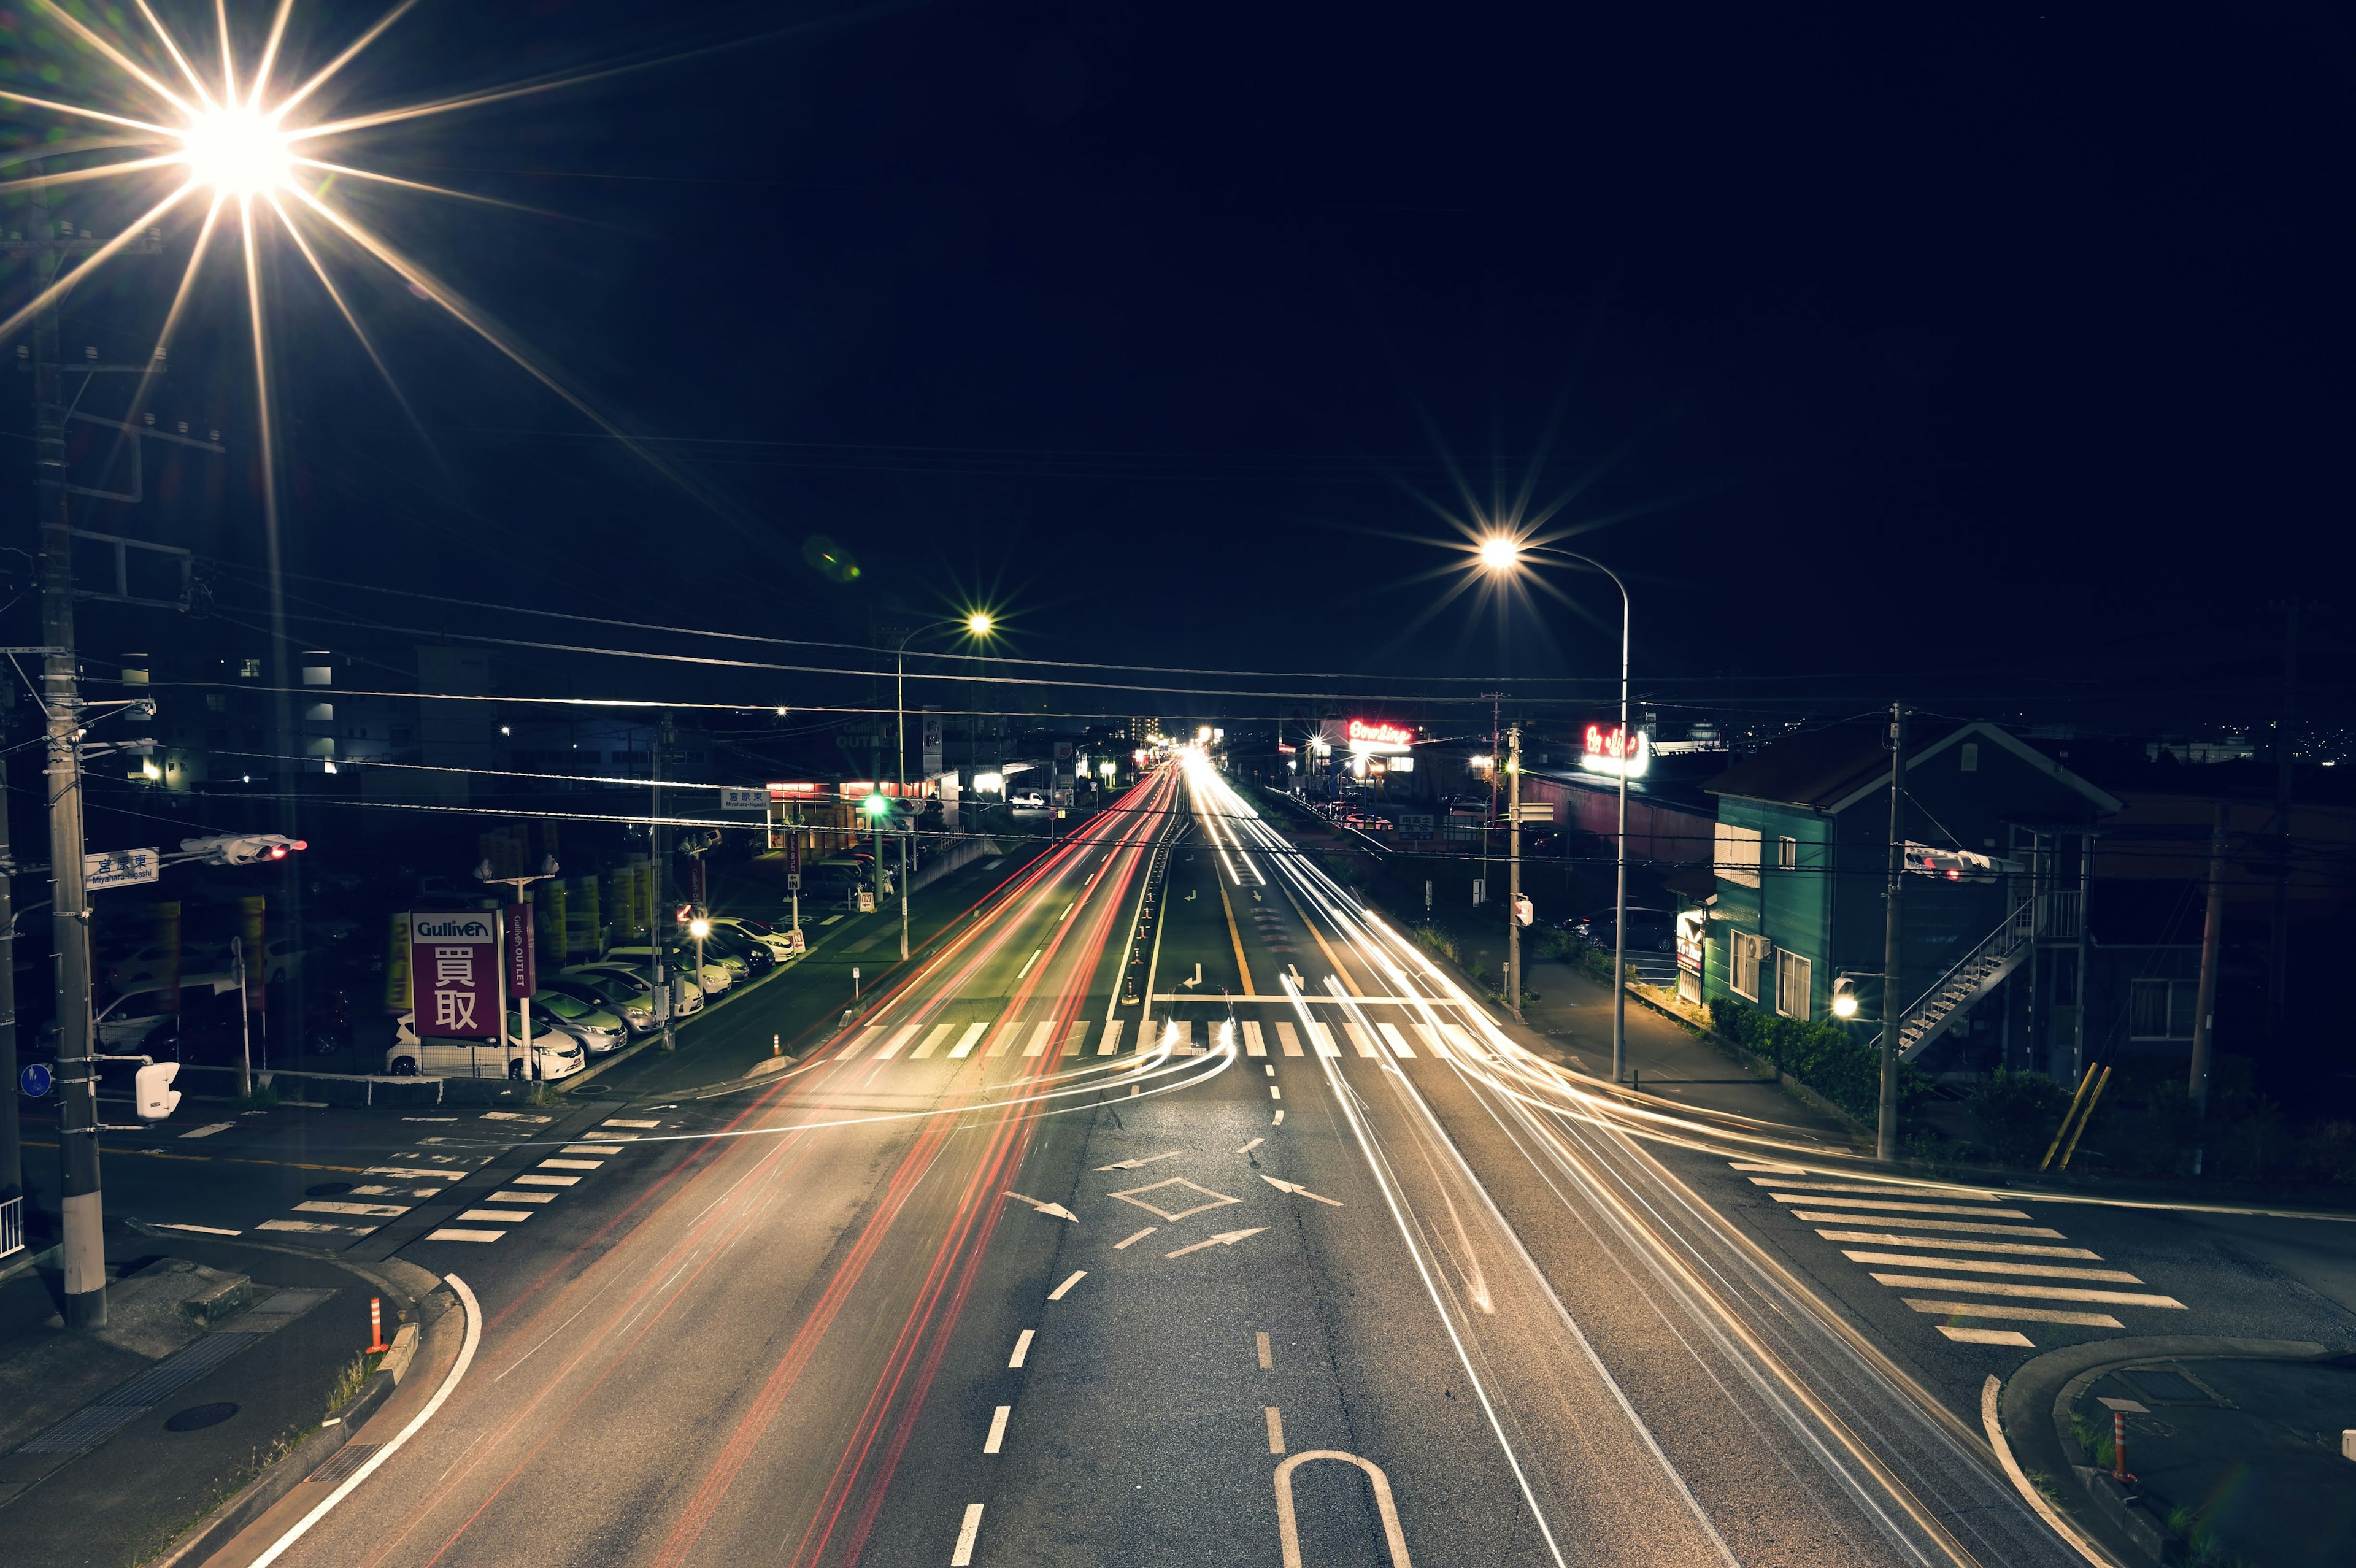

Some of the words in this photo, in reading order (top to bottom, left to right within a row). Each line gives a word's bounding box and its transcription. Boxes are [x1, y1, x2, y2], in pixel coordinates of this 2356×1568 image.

[1350, 720, 1411, 744] Bowling
[730, 791, 763, 801] 宮原東
[99, 854, 147, 874] 宮原東
[93, 869, 152, 885] Miyahara-higashi
[418, 920, 488, 936] Gulliver
[514, 915, 523, 947] Gulliver
[515, 948, 525, 986] OUTLET
[434, 947, 478, 1031] 買取
